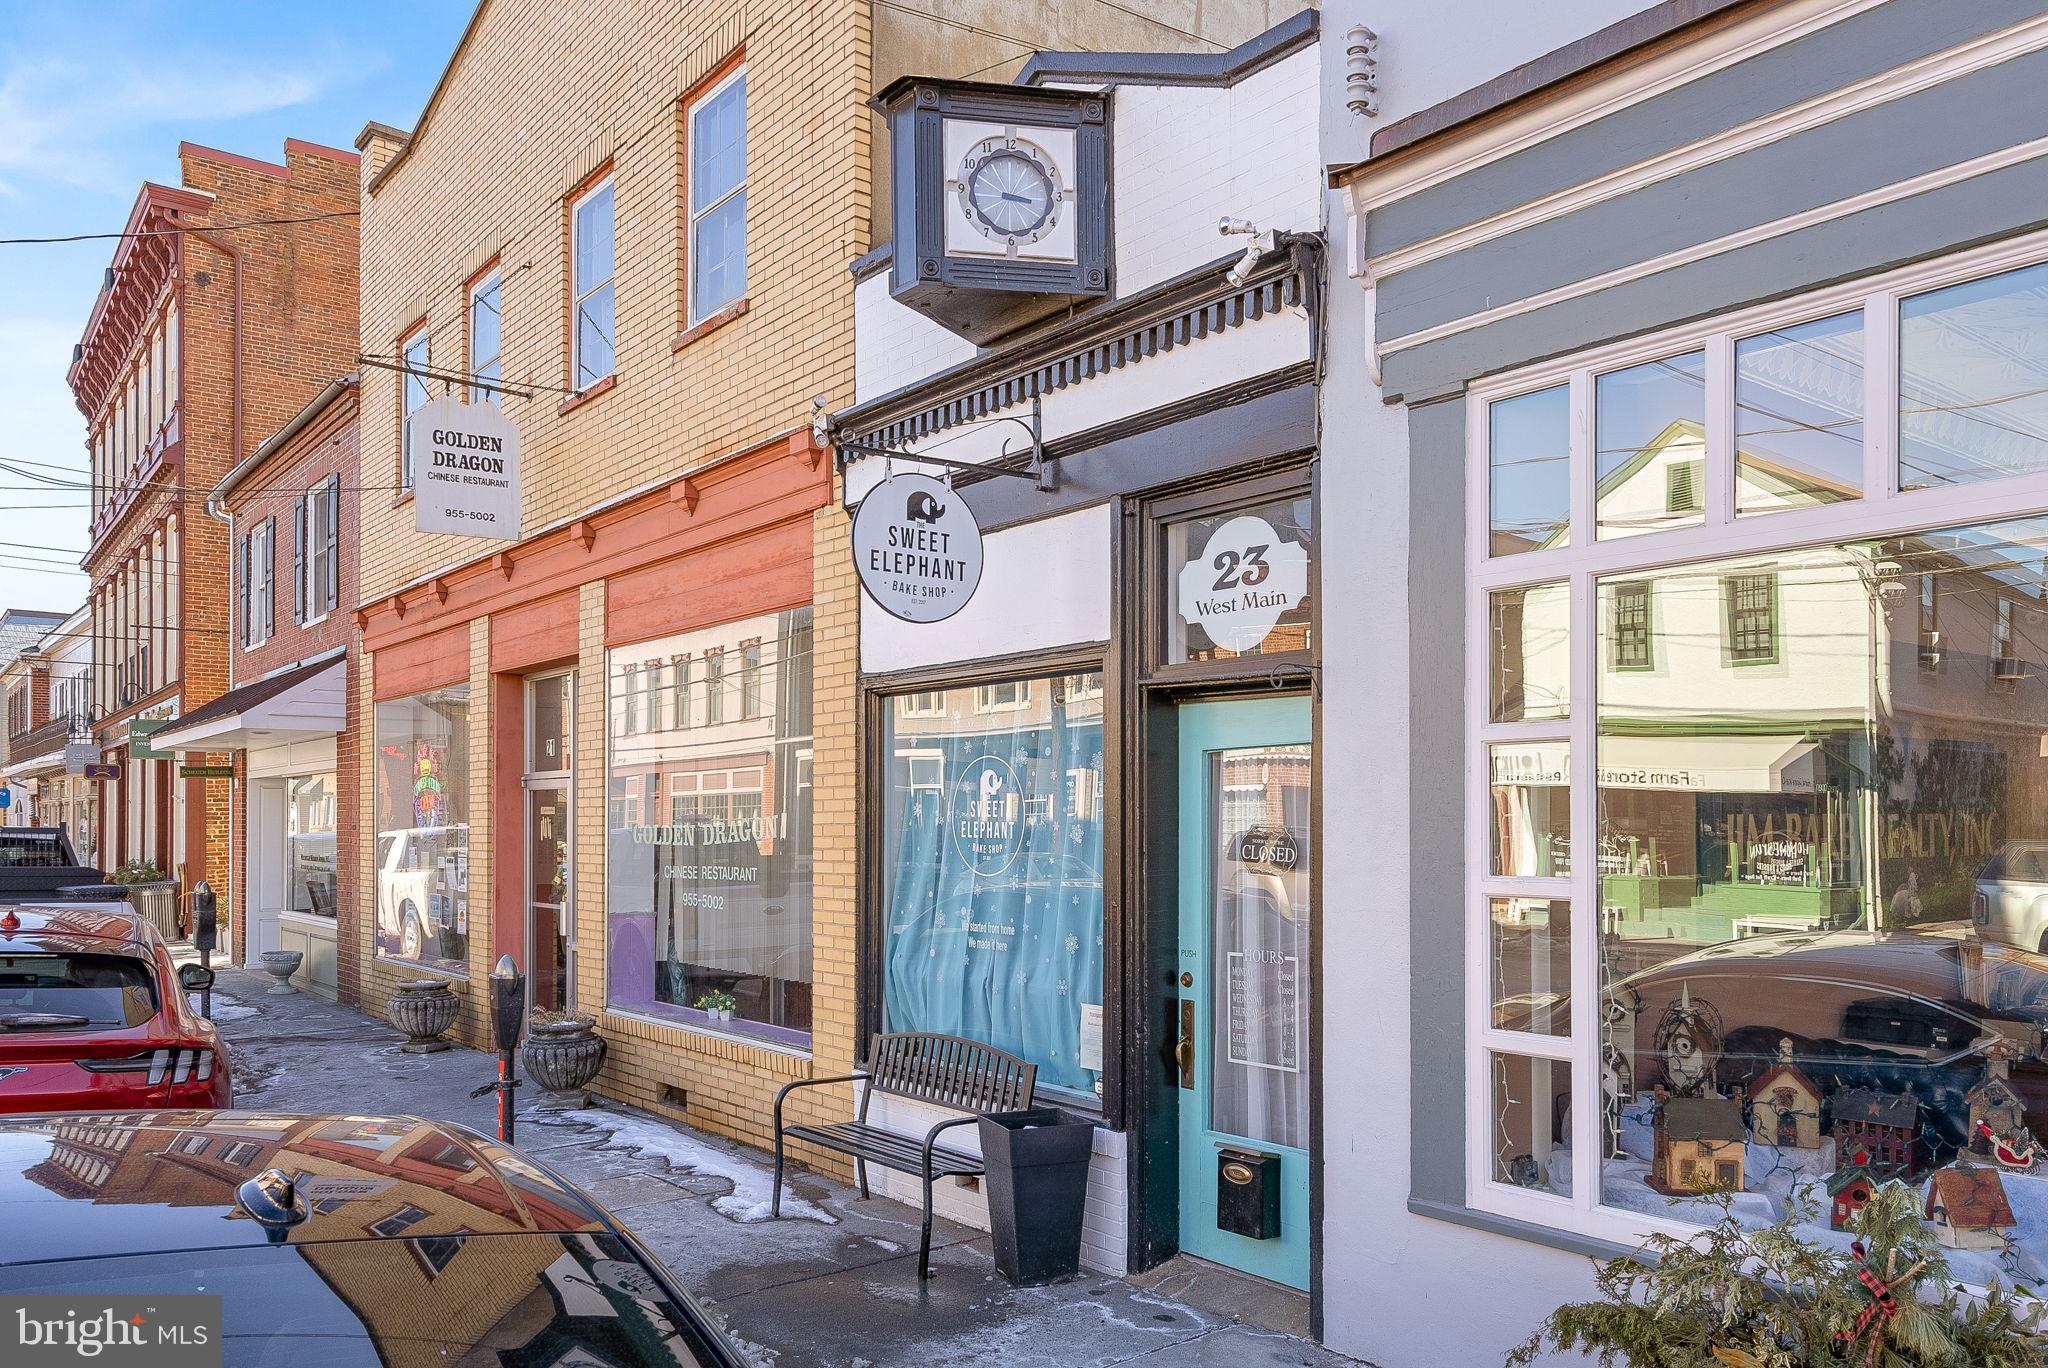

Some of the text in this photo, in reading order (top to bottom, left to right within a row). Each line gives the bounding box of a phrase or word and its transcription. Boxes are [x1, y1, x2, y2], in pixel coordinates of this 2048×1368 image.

[982, 142, 992, 153] 11
[1005, 139, 1016, 150] 12
[1032, 148, 1037, 158] 1
[964, 158, 976, 170] 10
[1050, 166, 1056, 177] 2
[958, 183, 965, 194] 9
[1056, 191, 1062, 202] 3
[966, 208, 972, 220] 8
[1050, 216, 1056, 226] 4
[984, 228, 990, 238] 7
[1032, 232, 1038, 242] 5
[1008, 236, 1015, 246] 6
[432, 429, 503, 453] GOLDEN
[432, 450, 504, 474] DRAGON
[427, 472, 510, 488] CHINESE RESTAURANT
[445, 508, 496, 522] 955-5002
[916, 521, 926, 529] THE
[888, 525, 950, 554] SWEET
[870, 549, 967, 582] ELEPHANT
[1211, 544, 1270, 592] 23
[892, 580, 947, 598] BAKE SHOP
[1196, 590, 1288, 616] West Main
[546, 740, 555, 756] 21
[970, 800, 1004, 818] SWEET
[632, 815, 778, 846] GOLDEN DRAGON
[961, 820, 1014, 839] ELEPHANT
[972, 843, 1002, 854] BAKE SHOP
[1242, 844, 1295, 862] CLOSED
[664, 865, 758, 882] CHINESE RESTAURANT
[682, 893, 724, 910] 955-5002
[970, 922, 987, 932] started
[1001, 923, 1016, 936] home
[977, 938, 990, 950] made
[1181, 949, 1196, 958] PUSH
[1244, 950, 1284, 964] HOURS
[1278, 970, 1294, 982] Closed
[1278, 984, 1294, 996] Closed
[1278, 1054, 1294, 1066] Closed
